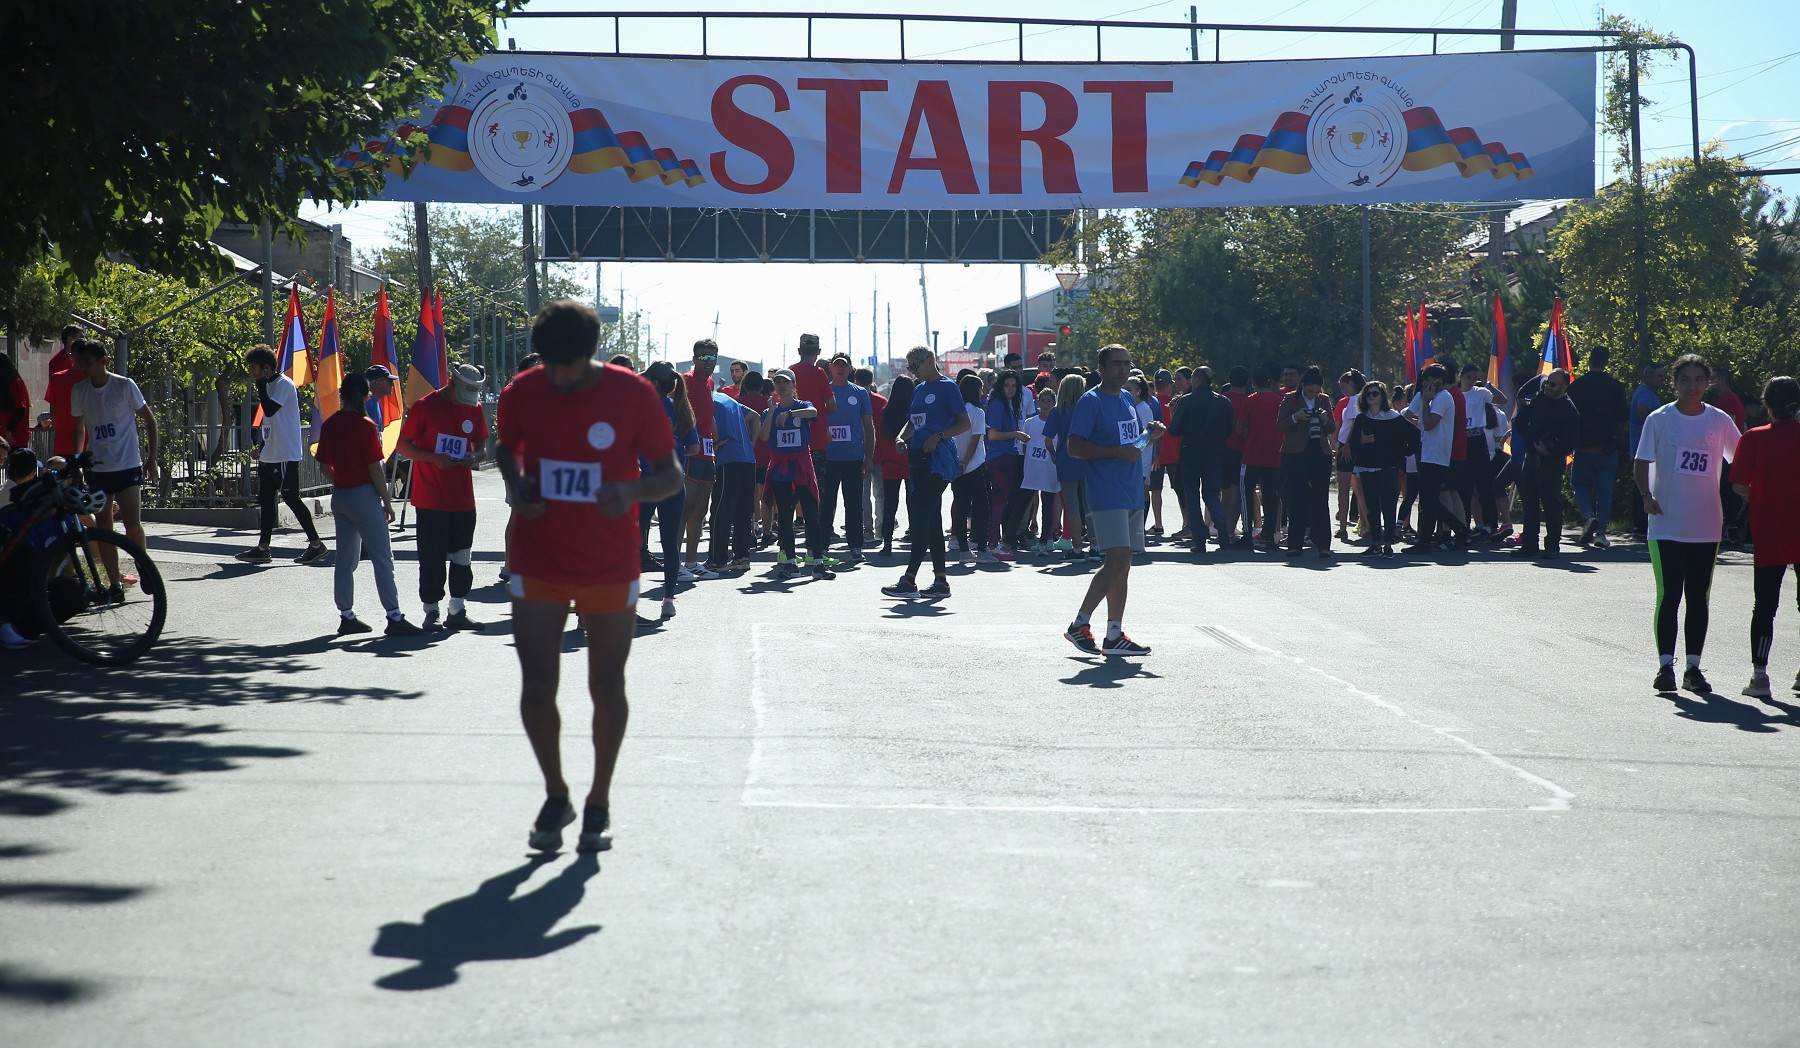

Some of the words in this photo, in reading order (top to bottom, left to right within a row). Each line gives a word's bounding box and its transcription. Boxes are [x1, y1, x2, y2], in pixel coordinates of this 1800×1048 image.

[472, 66, 544, 93] ՎԱՐՉԱՊԵՏԻ
[545, 73, 581, 109] ԳԱՎԱԹ
[1310, 71, 1379, 98] ՎԱՐՉԱՊԵՏԻ
[1380, 76, 1414, 109] ԳԱՎԱԹ
[709, 74, 1173, 194] START
[94, 423, 116, 440] 206
[781, 432, 796, 444] 417
[831, 427, 847, 439] 370
[1121, 422, 1138, 440] 392
[441, 437, 462, 455] 149
[1031, 446, 1047, 460] 254
[1680, 450, 1708, 472] 235
[552, 468, 591, 497] 174
